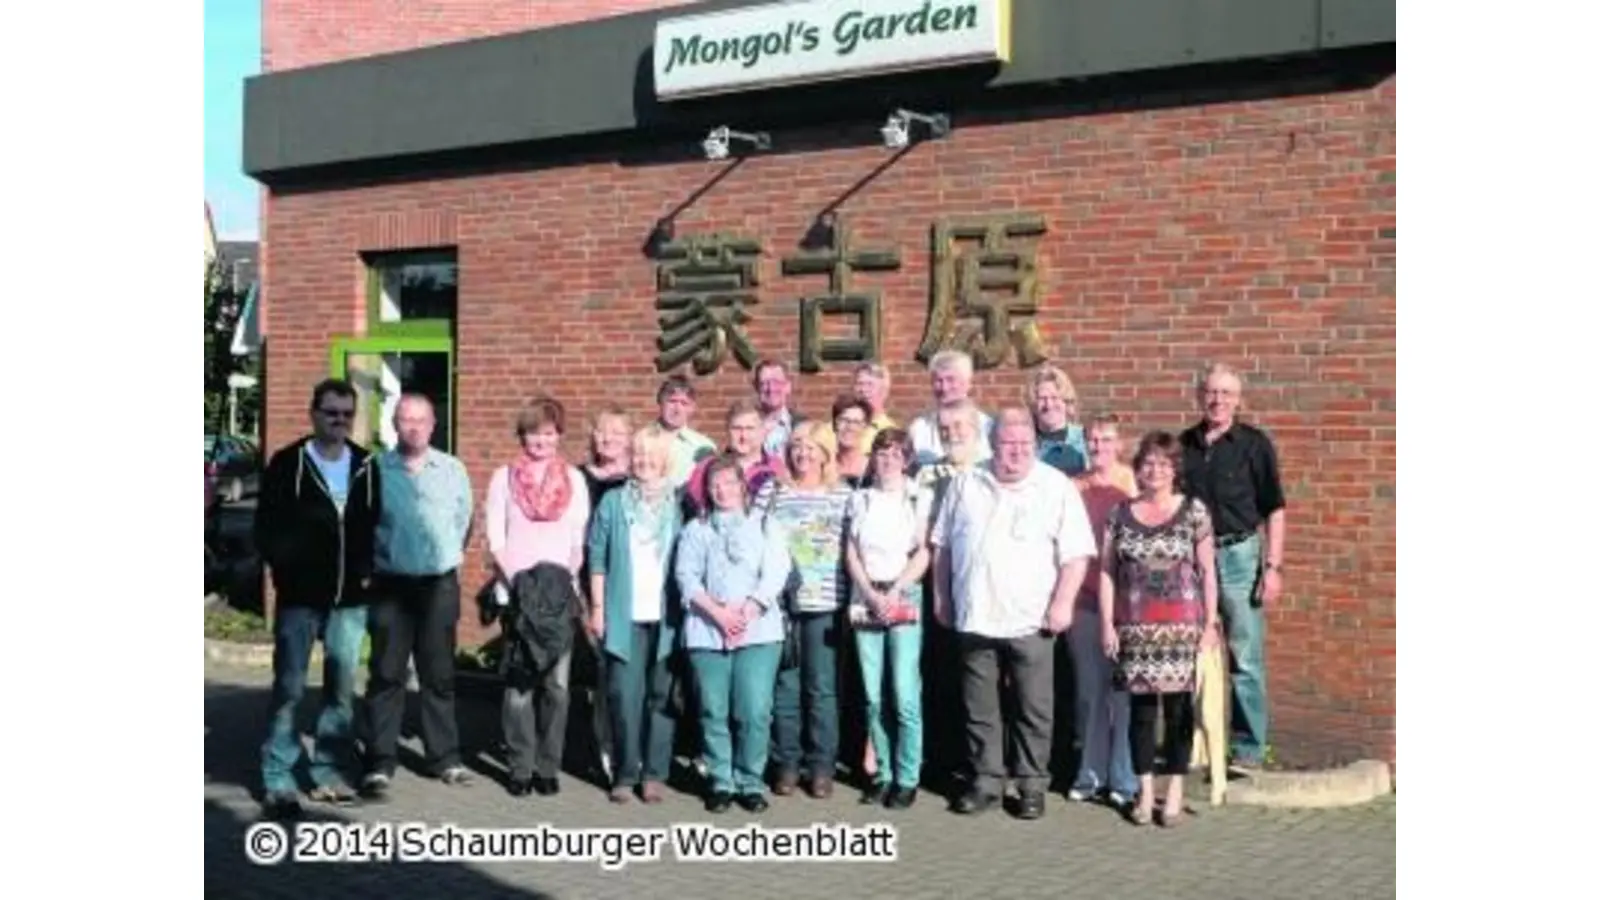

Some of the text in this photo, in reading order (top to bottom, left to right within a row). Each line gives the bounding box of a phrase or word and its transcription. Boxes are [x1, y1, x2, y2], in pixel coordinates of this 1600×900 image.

[664, 0, 979, 73] Mongol's Garden
[655, 213, 1049, 375] 蒙古原
